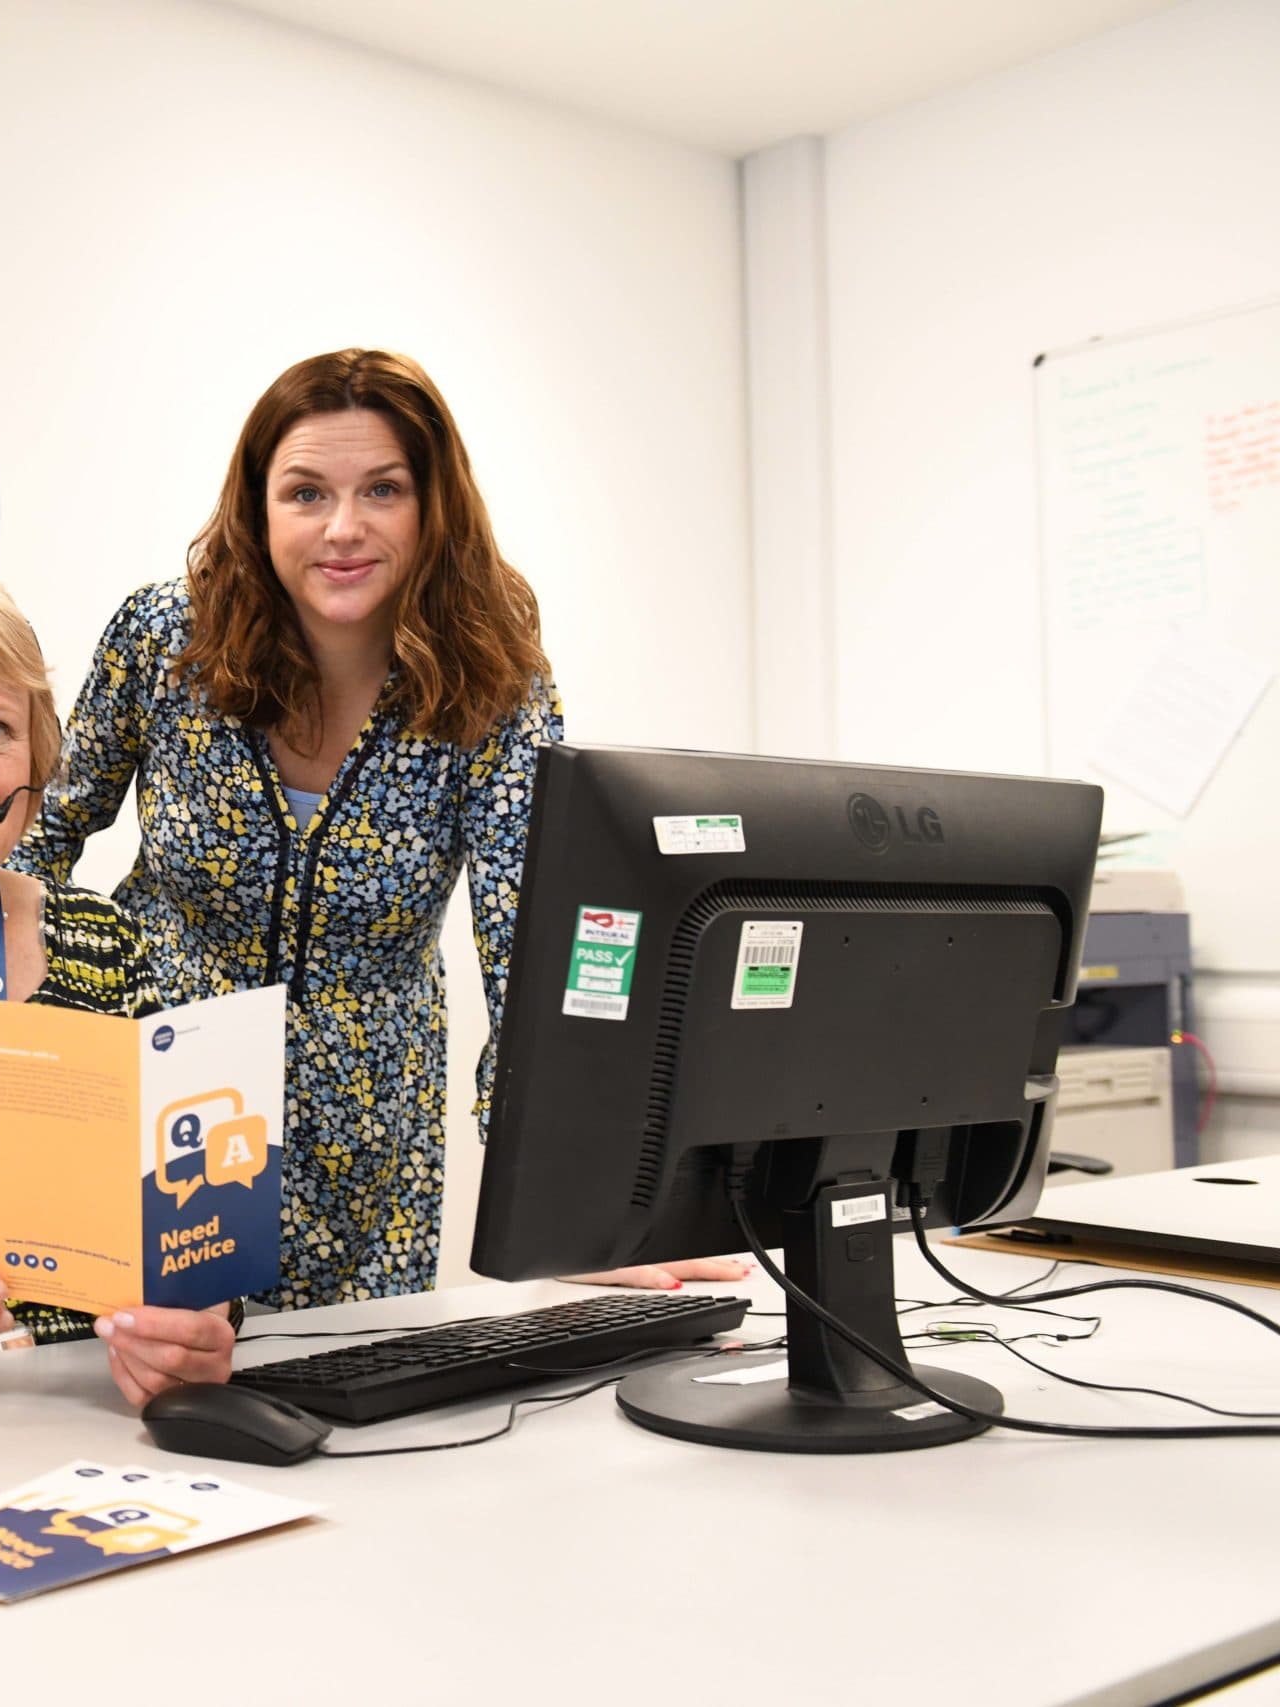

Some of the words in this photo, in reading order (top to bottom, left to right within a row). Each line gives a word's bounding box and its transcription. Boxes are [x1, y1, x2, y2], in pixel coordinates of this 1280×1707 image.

[893, 806, 945, 845] LG
[584, 929, 630, 939] INTEGRAL
[576, 948, 614, 963] PASS
[171, 1113, 203, 1149] Q
[221, 1133, 254, 1168] A
[160, 1215, 220, 1253] Need
[161, 1238, 236, 1277] Advice
